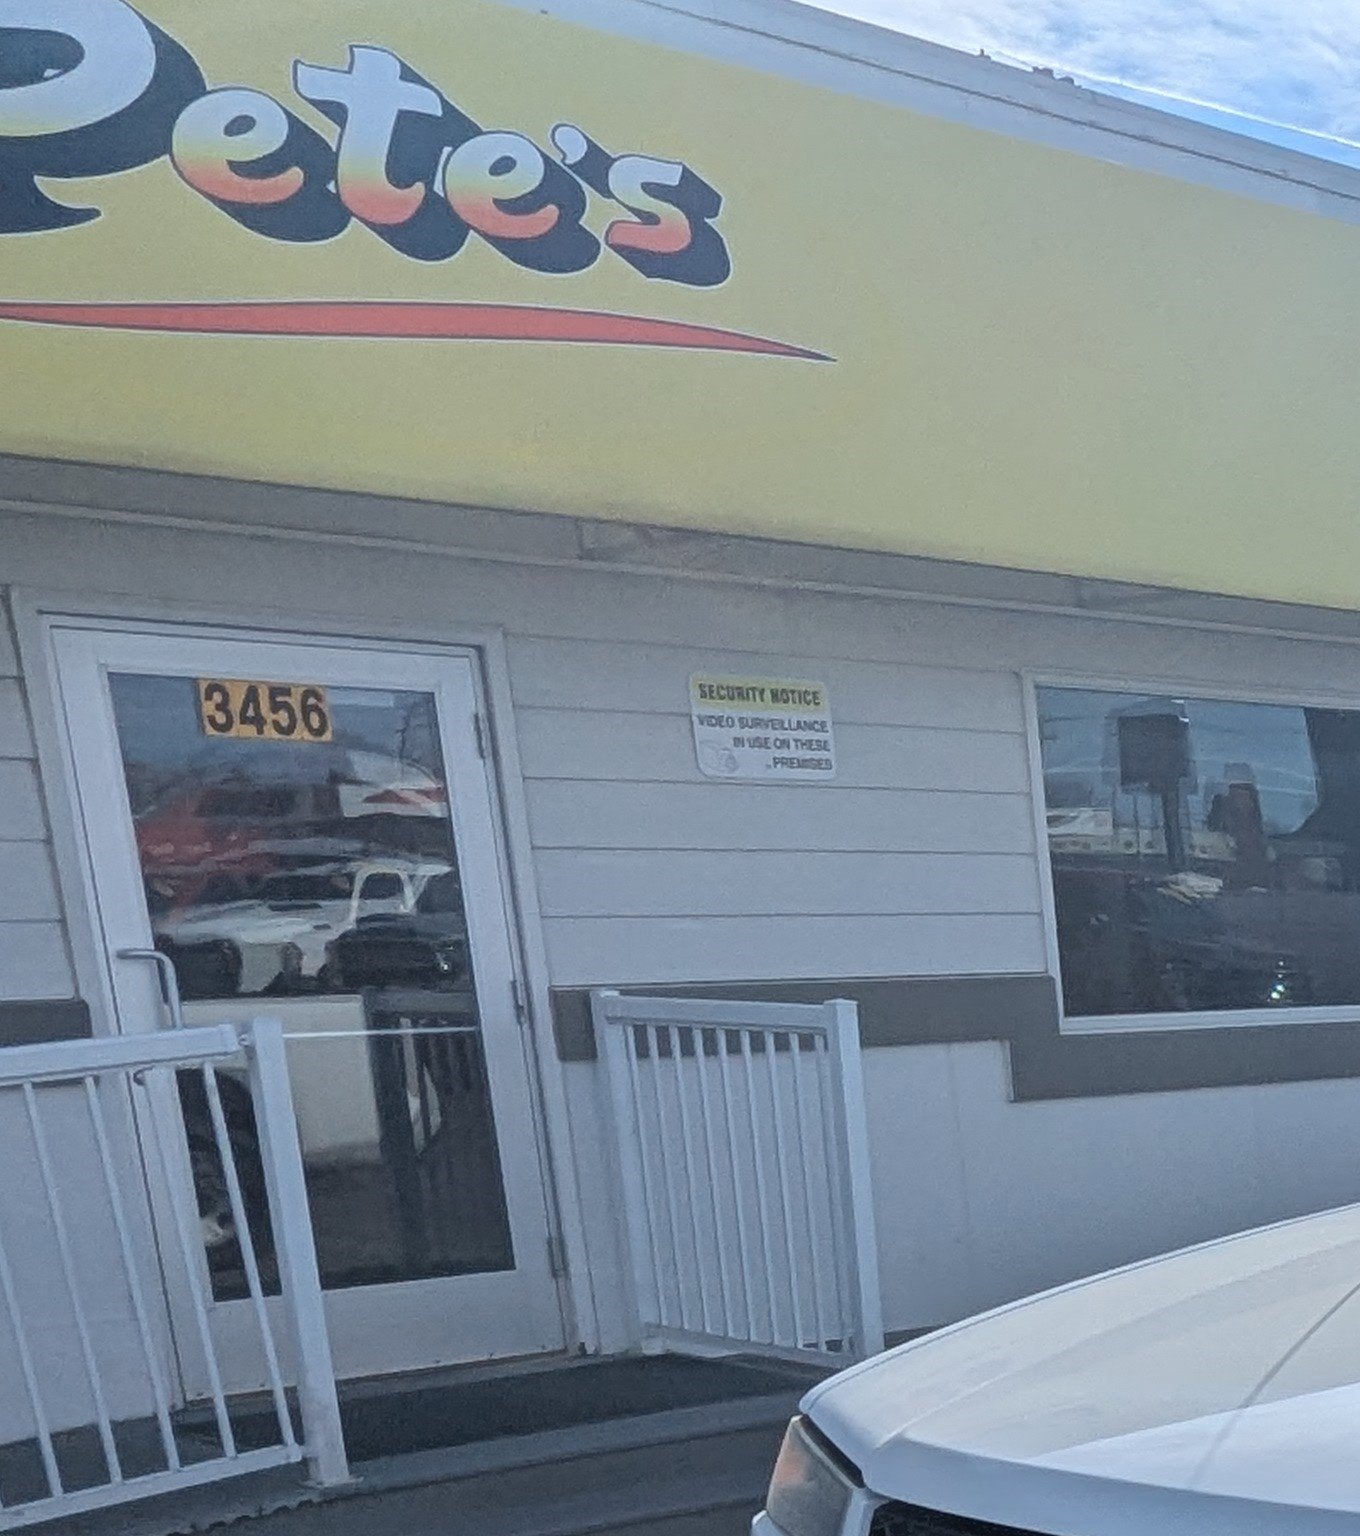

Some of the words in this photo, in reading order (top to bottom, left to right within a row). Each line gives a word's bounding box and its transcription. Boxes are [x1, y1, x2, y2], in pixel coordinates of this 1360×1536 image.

[698, 683, 765, 702] SECURITY
[769, 688, 821, 706] NOTICE
[204, 682, 329, 738] 3456
[698, 714, 735, 729] VIDEO
[737, 716, 829, 733] SURVEILLANCE
[733, 736, 745, 748] IN
[746, 736, 771, 750] USE
[773, 737, 791, 750] ON
[792, 738, 831, 752] THESE
[772, 756, 832, 771] PREMISES
